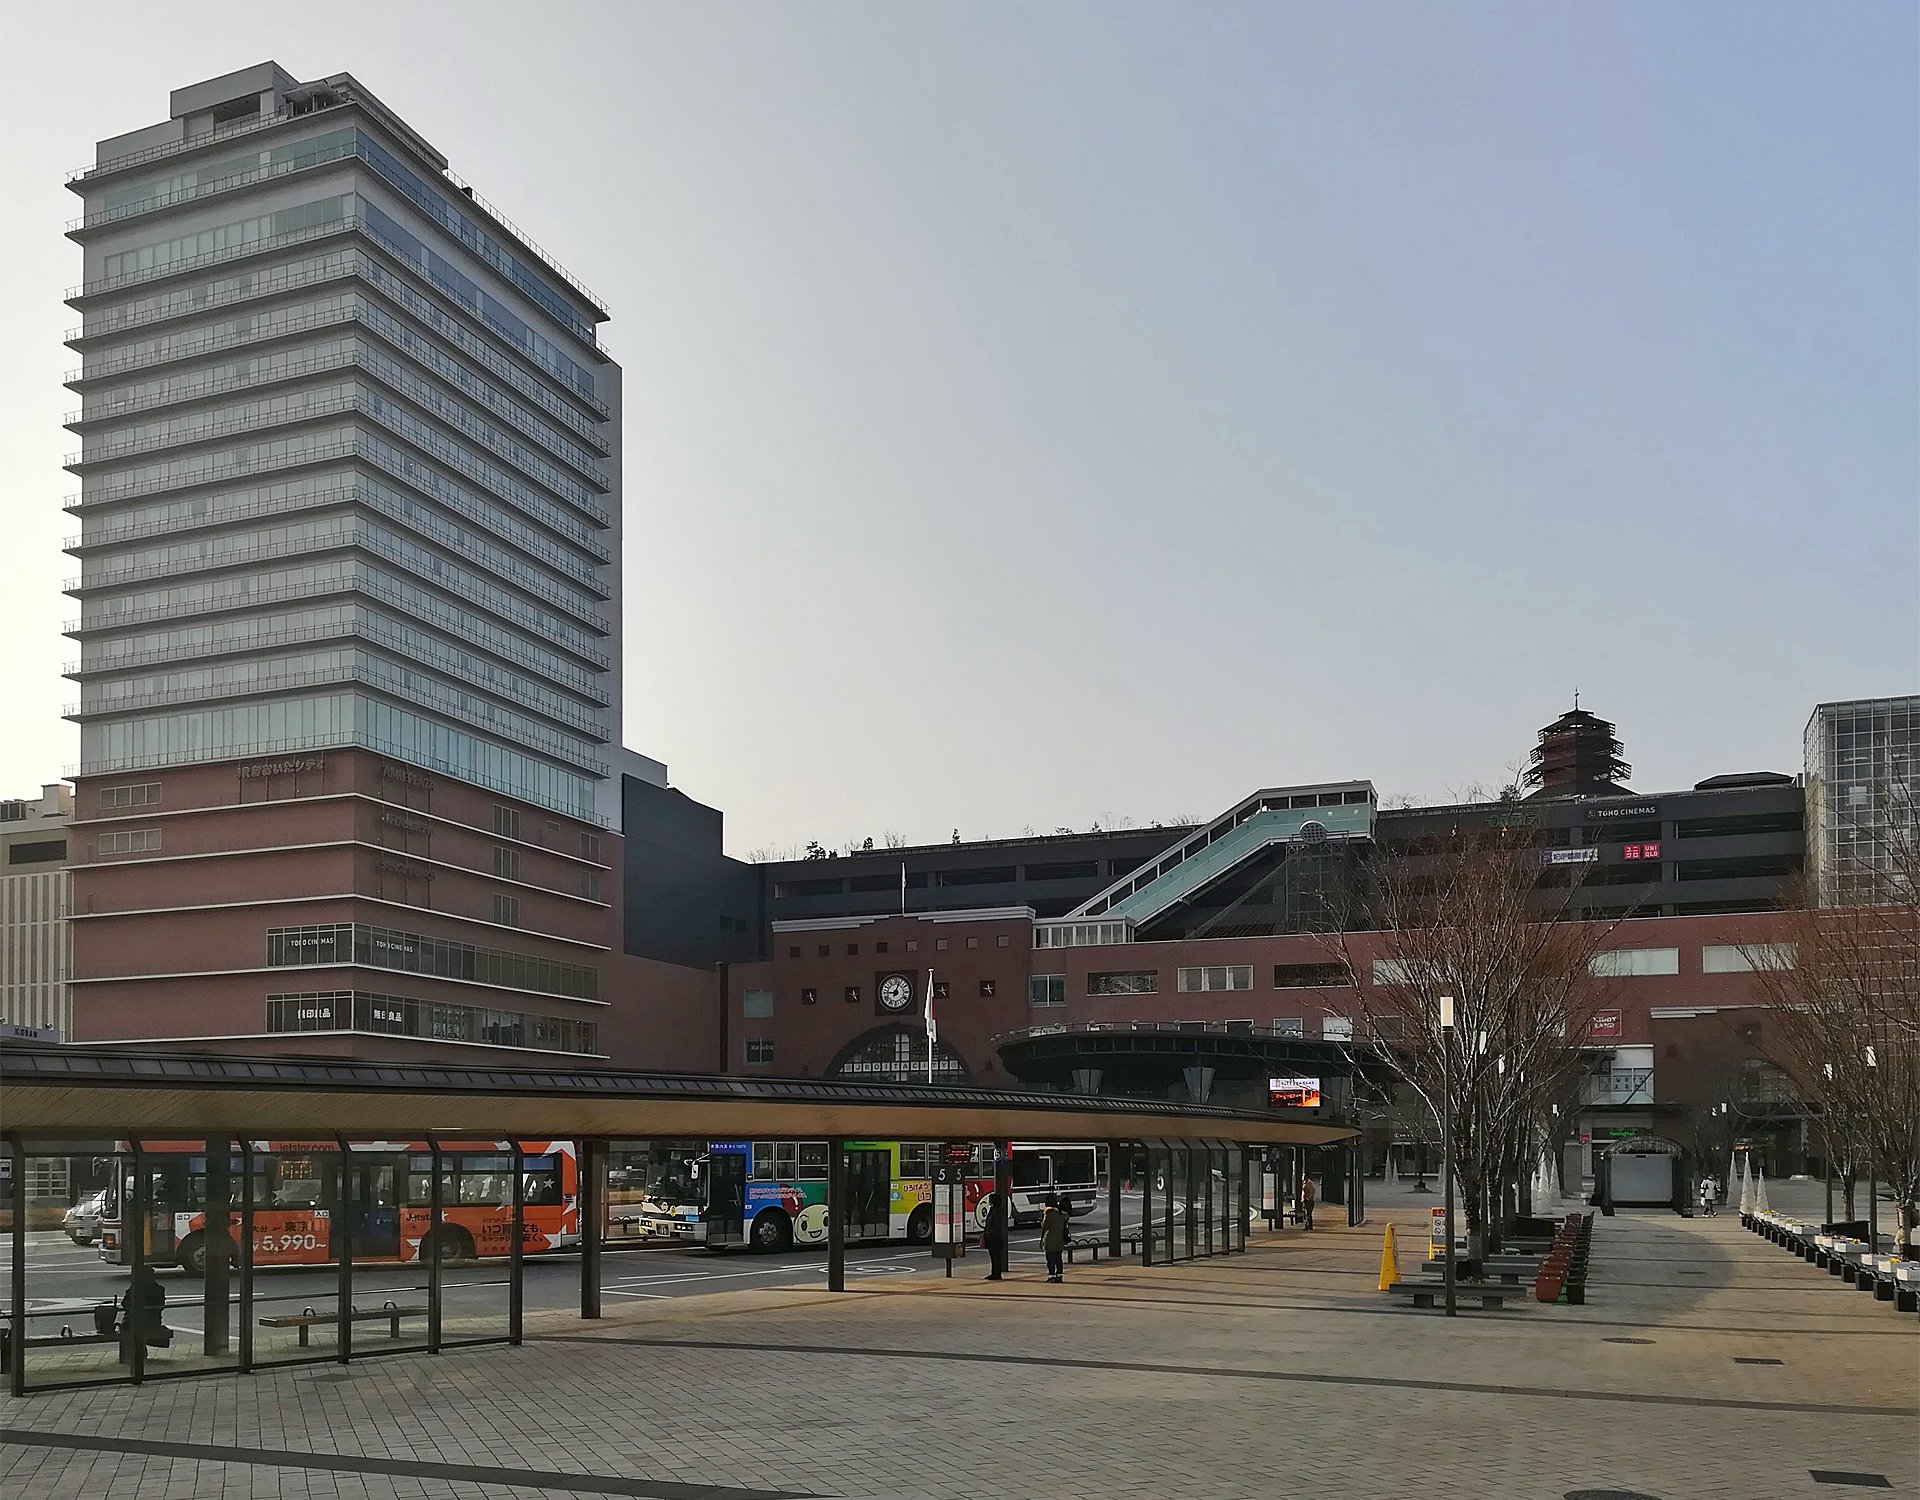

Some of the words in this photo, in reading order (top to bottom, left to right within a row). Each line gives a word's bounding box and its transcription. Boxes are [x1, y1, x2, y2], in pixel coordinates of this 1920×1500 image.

[1597, 809, 1619, 817] TOHO
[1620, 806, 1656, 816] CINEMAS
[1265, 1163, 1272, 1172] 6
[938, 1168, 946, 1181] 5
[956, 1168, 962, 1181] 5
